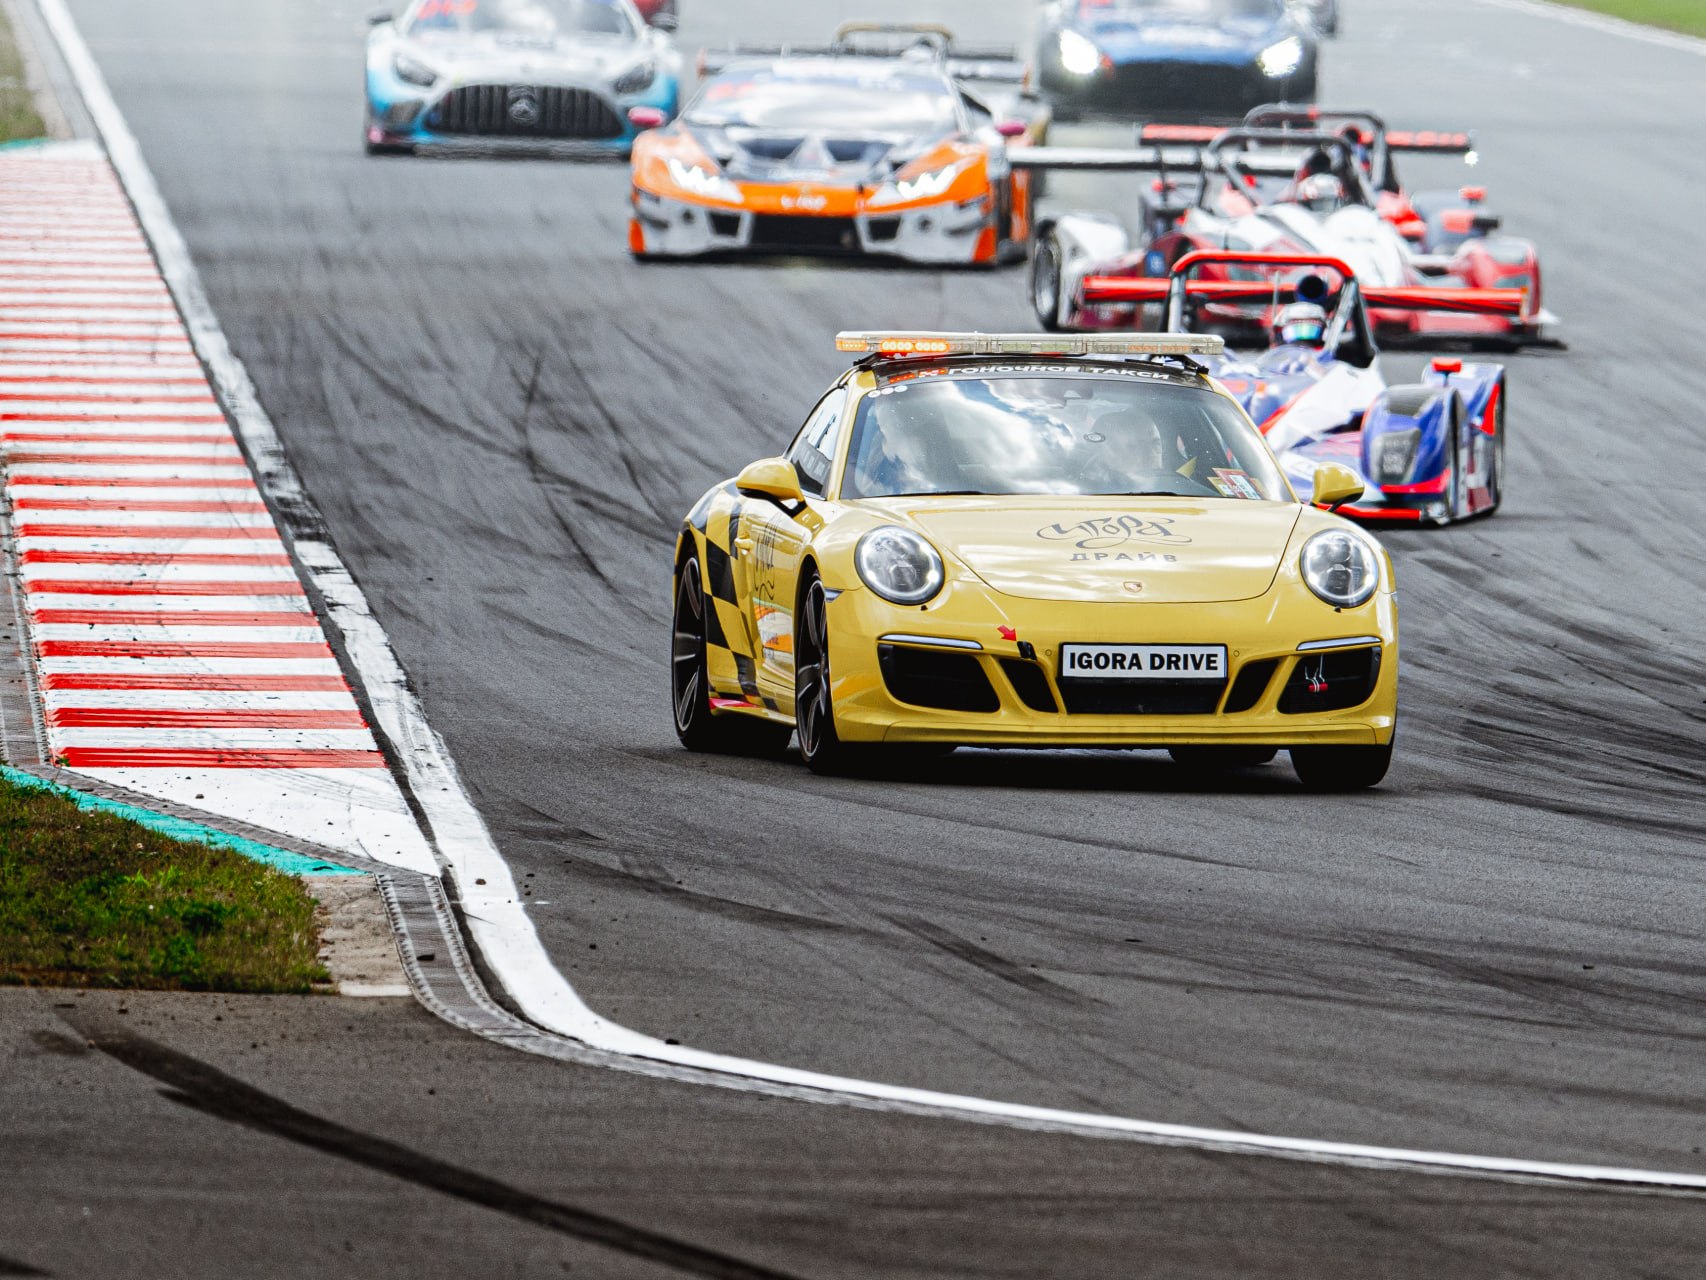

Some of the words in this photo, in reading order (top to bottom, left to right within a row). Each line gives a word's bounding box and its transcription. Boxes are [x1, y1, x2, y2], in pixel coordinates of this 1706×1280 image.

[948, 365, 1081, 375] ГОНОЧНОЕ
[1090, 367, 1170, 380] ТАКСИ
[1069, 551, 1178, 563] ДРАЙВ
[1069, 652, 1143, 671] IGORA
[1149, 653, 1219, 671] DRIVE
